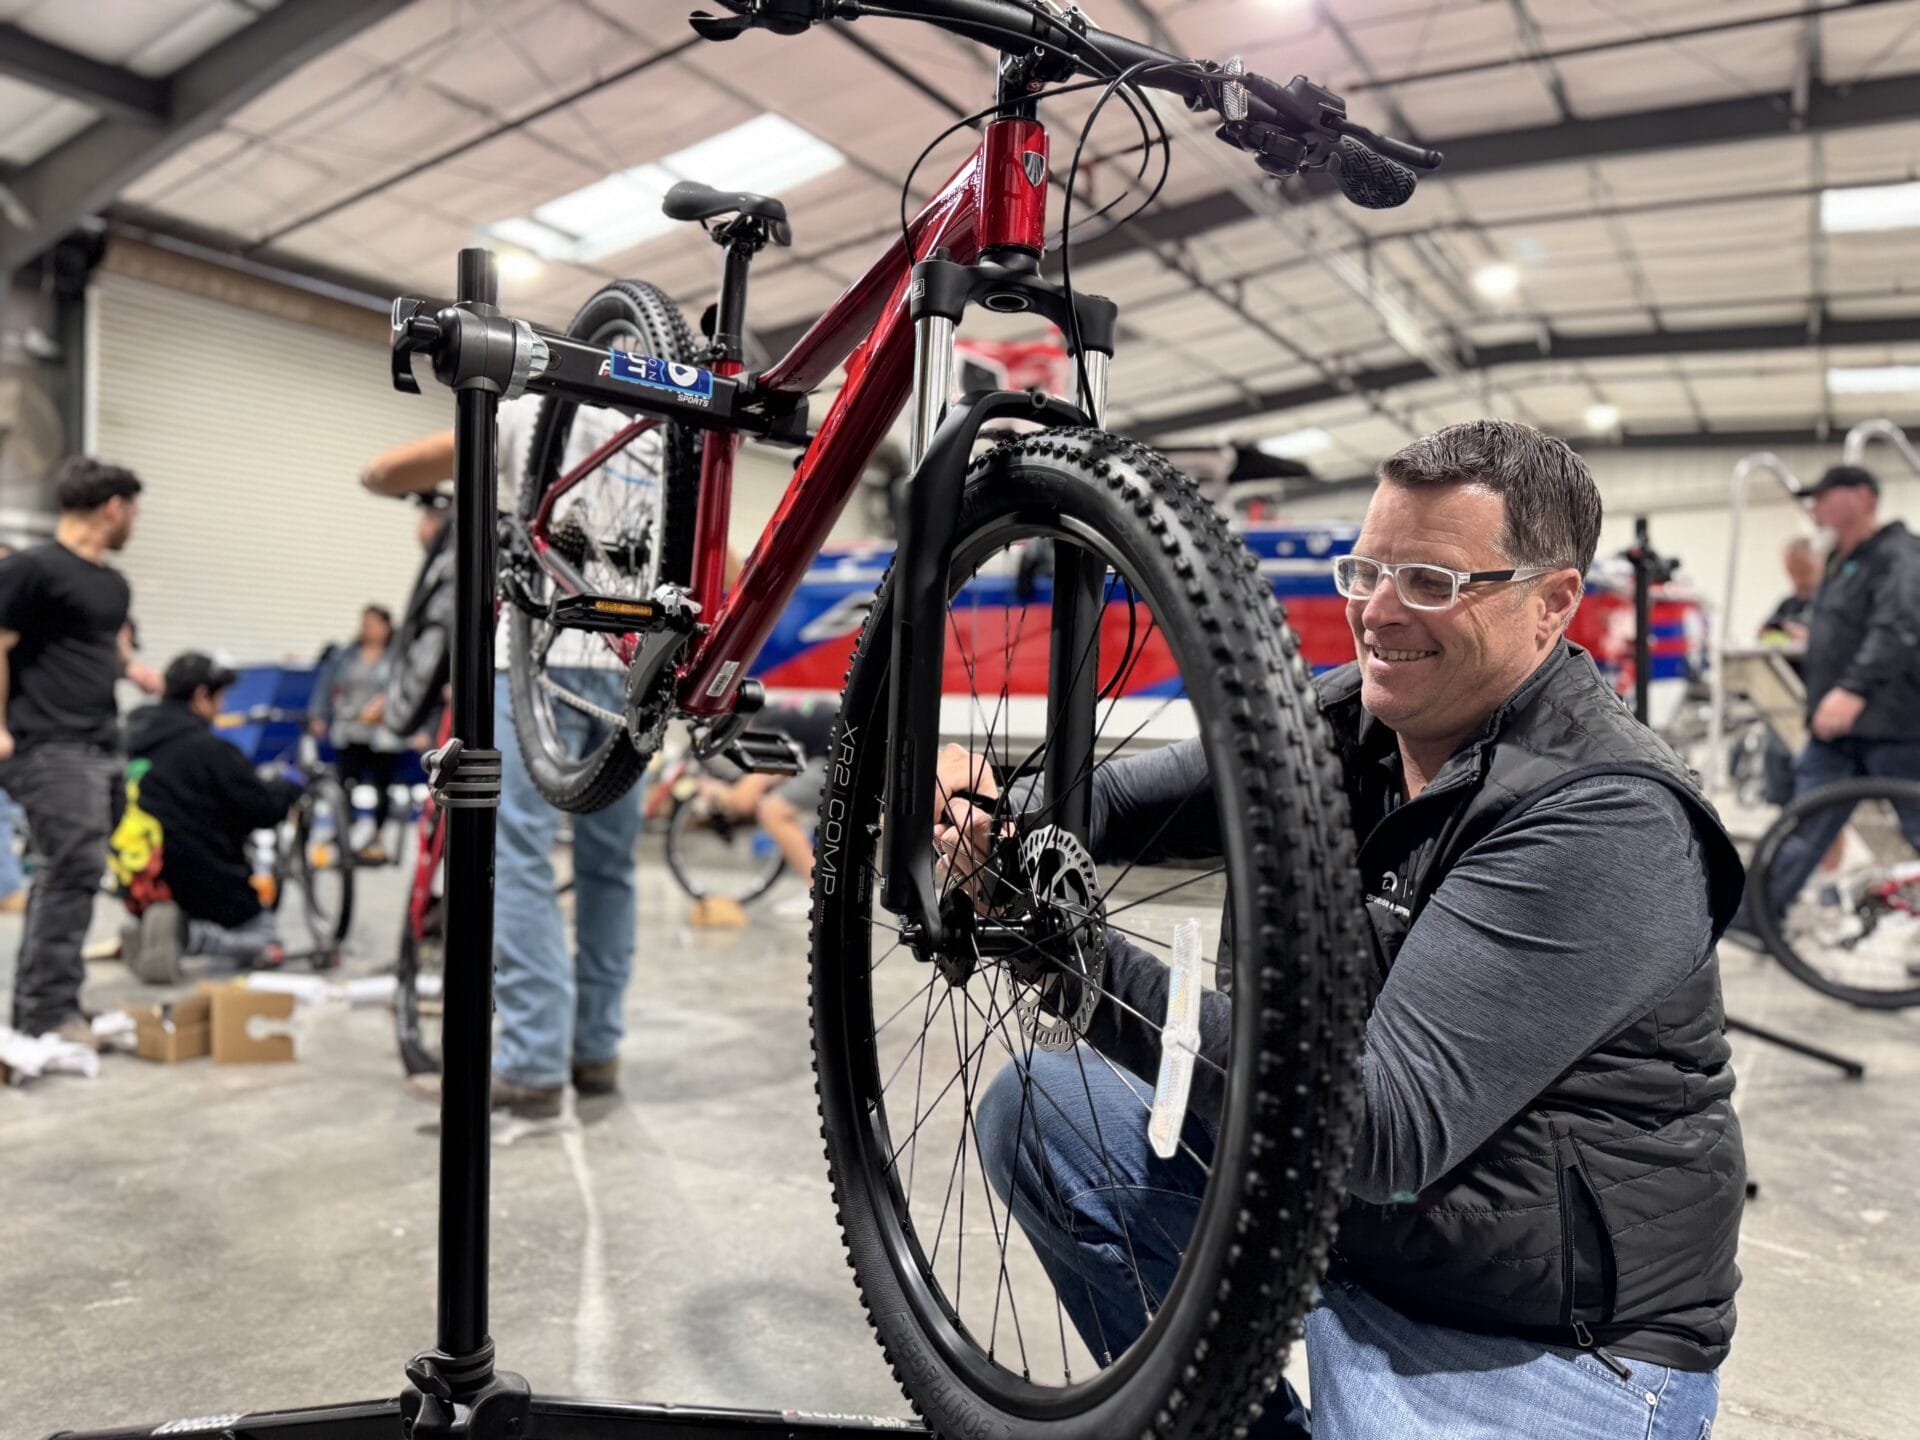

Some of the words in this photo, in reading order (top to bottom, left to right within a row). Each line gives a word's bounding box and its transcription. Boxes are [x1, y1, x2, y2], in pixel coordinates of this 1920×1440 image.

[678, 393, 710, 408] SPORTS
[833, 719, 859, 786] XR2
[821, 798, 845, 895] COMP
